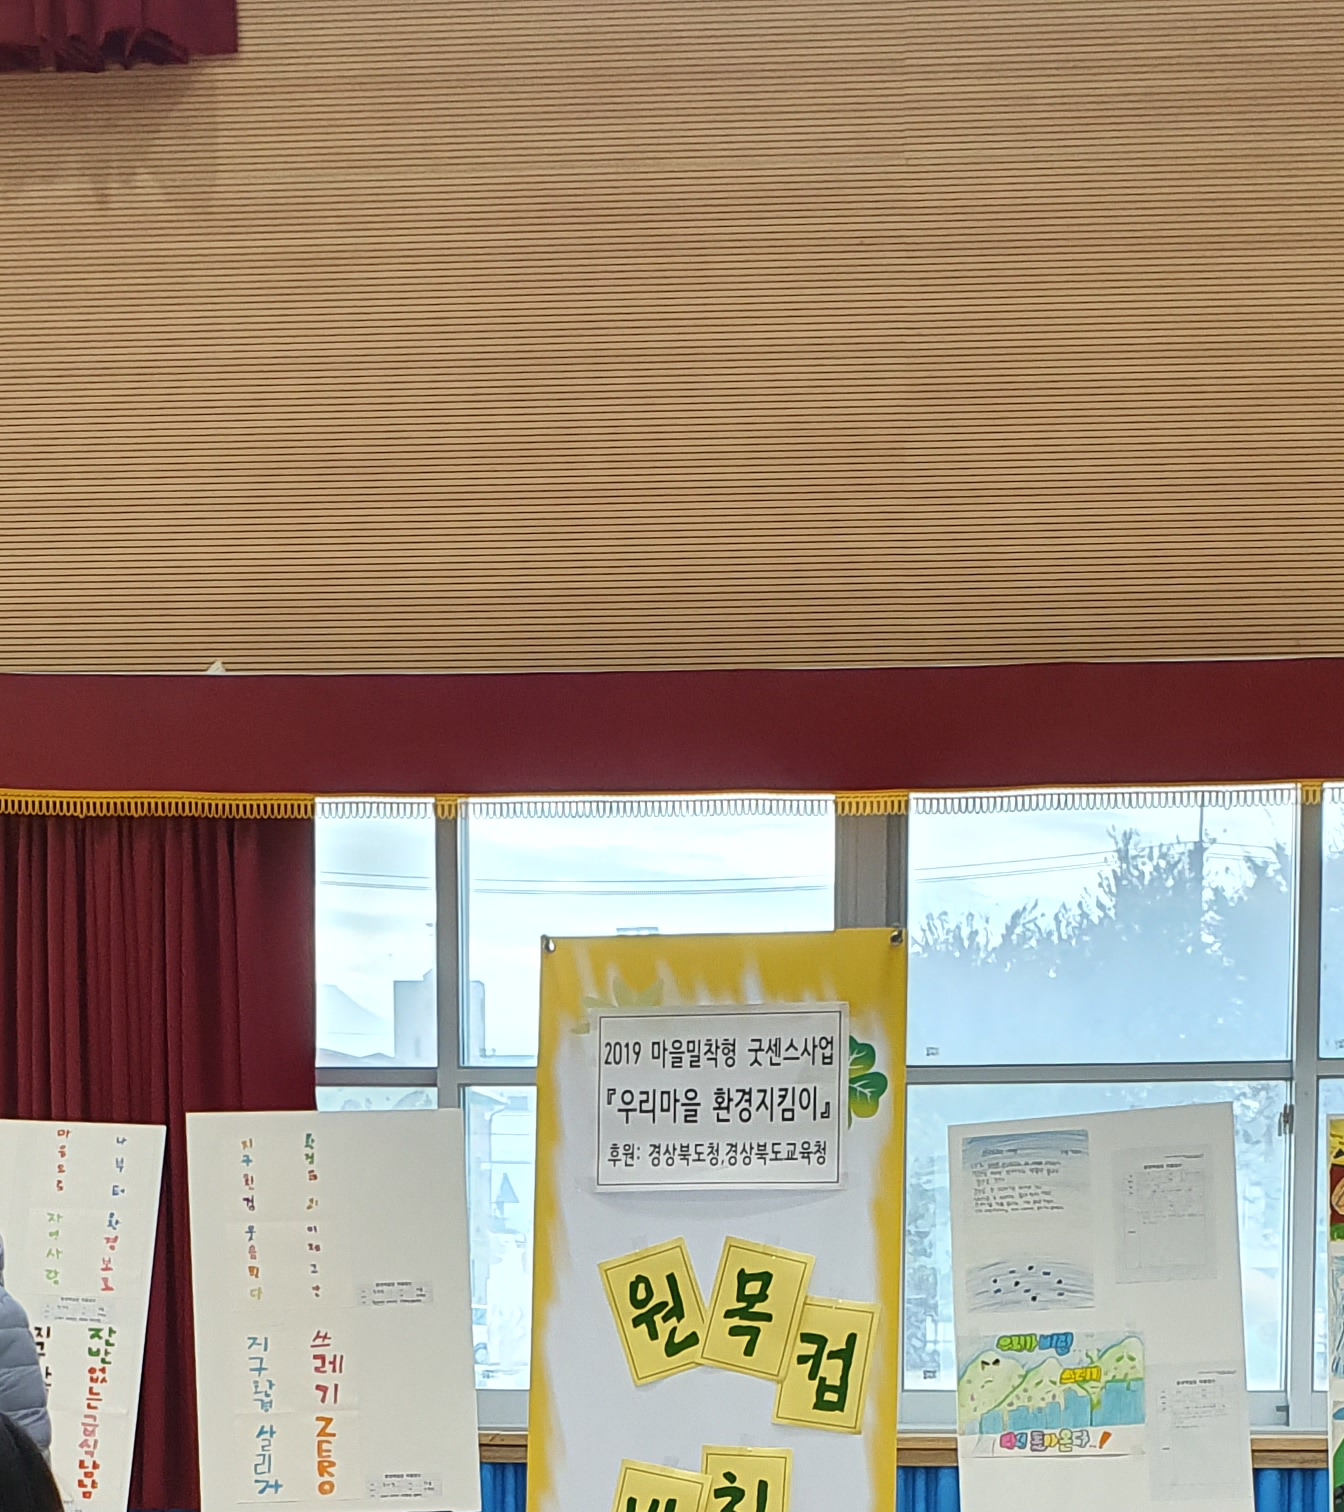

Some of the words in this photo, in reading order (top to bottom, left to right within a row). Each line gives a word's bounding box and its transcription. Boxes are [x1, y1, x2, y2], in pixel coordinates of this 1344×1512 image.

[604, 1041, 642, 1065] 2019
[652, 1038, 737, 1068] 마을밀착형
[747, 1035, 834, 1067] 굿센스사업
[112, 1136, 127, 1196] 나부터
[607, 1143, 641, 1168] 후원:
[310, 1330, 344, 1404] 쓰레기
[628, 1268, 857, 1412] 원목컵
[254, 1425, 283, 1494] 살리자
[315, 1416, 337, 1495] ZERO
